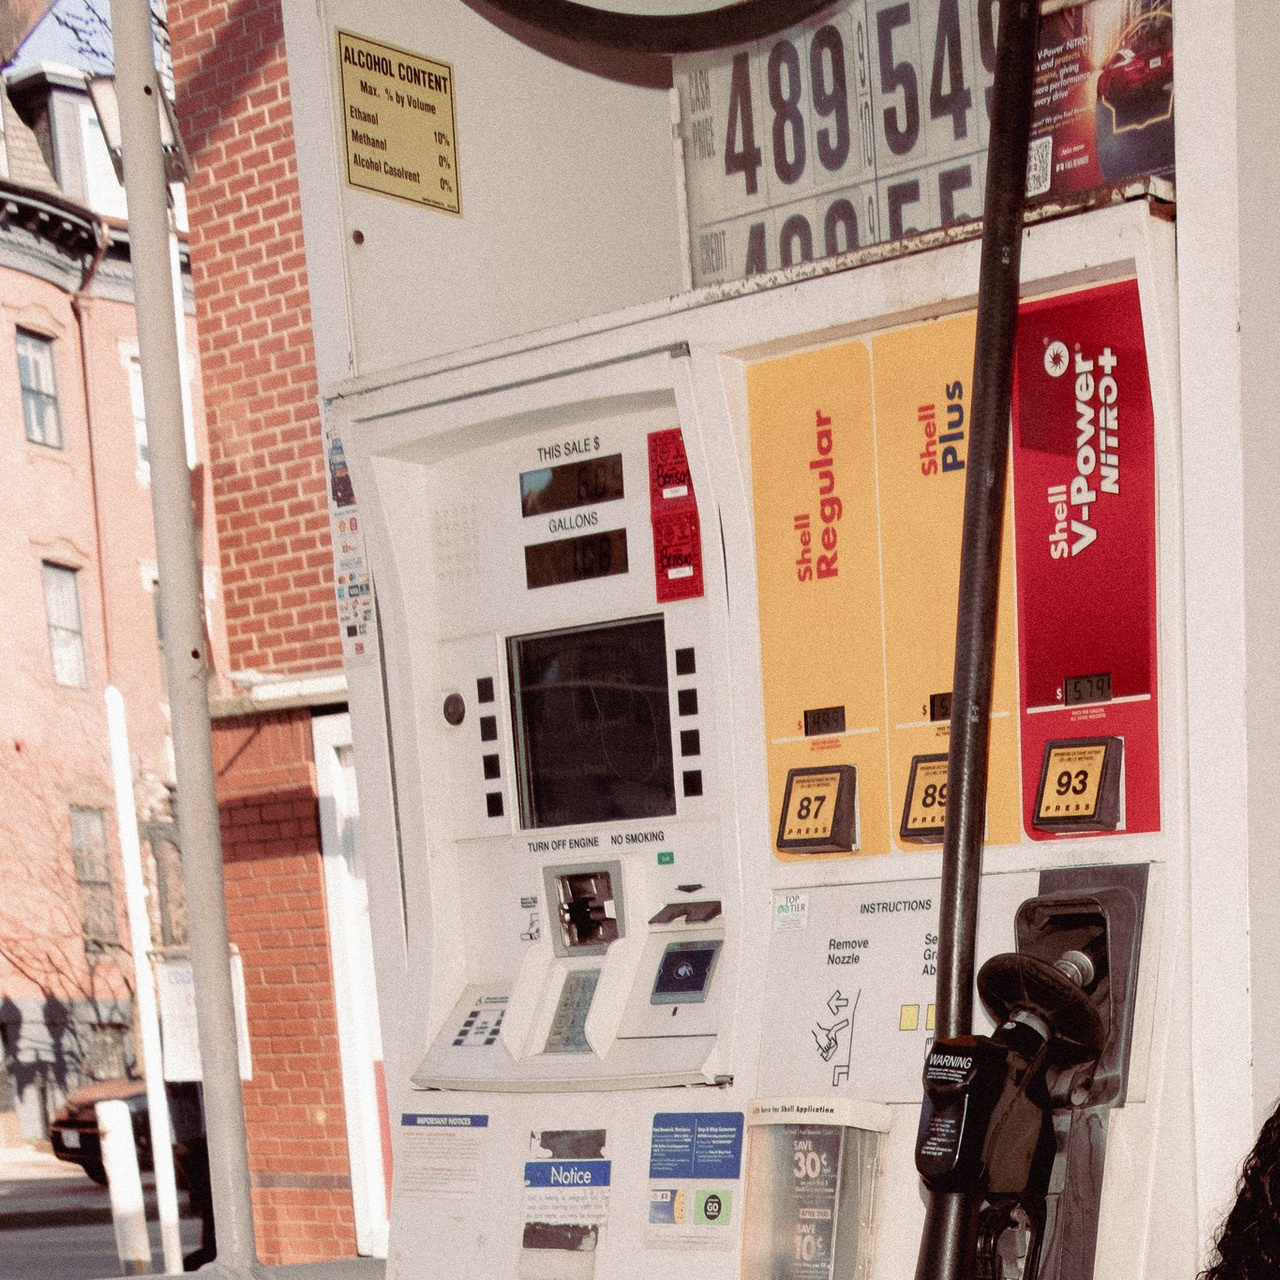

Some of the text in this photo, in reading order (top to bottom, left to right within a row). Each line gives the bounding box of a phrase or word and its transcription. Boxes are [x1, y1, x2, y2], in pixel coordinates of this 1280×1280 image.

[344, 46, 448, 94] ALCOHOL CONTENT
[360, 80, 436, 115] Max. % by Volume
[725, 24, 851, 196] 489
[350, 105, 450, 147] Ethanol 10%
[351, 129, 451, 170] Methanol 0%
[353, 153, 382, 173] Alcohol
[440, 178, 452, 193] 0%
[939, 379, 966, 473] Plus
[1098, 346, 1120, 495] NiTRO+
[537, 435, 601, 462] THIS SALE $
[917, 403, 938, 477] Shell
[1070, 350, 1098, 557] V-Power
[809, 409, 843, 580] Regular
[549, 511, 599, 534] GALLONS
[1047, 484, 1069, 560] Shell
[793, 513, 813, 583] Shell
[1056, 687, 1062, 700] $
[922, 704, 928, 716] $
[1055, 769, 1089, 796] 93
[797, 795, 827, 820] 87
[1045, 803, 1091, 812] PRESS
[912, 815, 945, 824] PRES
[788, 826, 827, 835] PRESS
[528, 831, 665, 852] TURN OFF ENGINE NO SMOKING
[785, 895, 800, 904] TOP
[790, 903, 806, 913] TIER
[860, 899, 932, 914] INSTRUCTIONS
[828, 938, 869, 950] Remove
[827, 953, 860, 965] Nozzle
[929, 1053, 973, 1069] WARNING
[781, 1105, 795, 1113] Shell
[796, 1105, 835, 1114] Application
[416, 1117, 471, 1126] IMPORTANT NOTICES
[793, 1140, 813, 1151] SAVE
[550, 1166, 592, 1185] Notice
[707, 1202, 719, 1212] GO
[797, 1224, 816, 1234] SAVE
